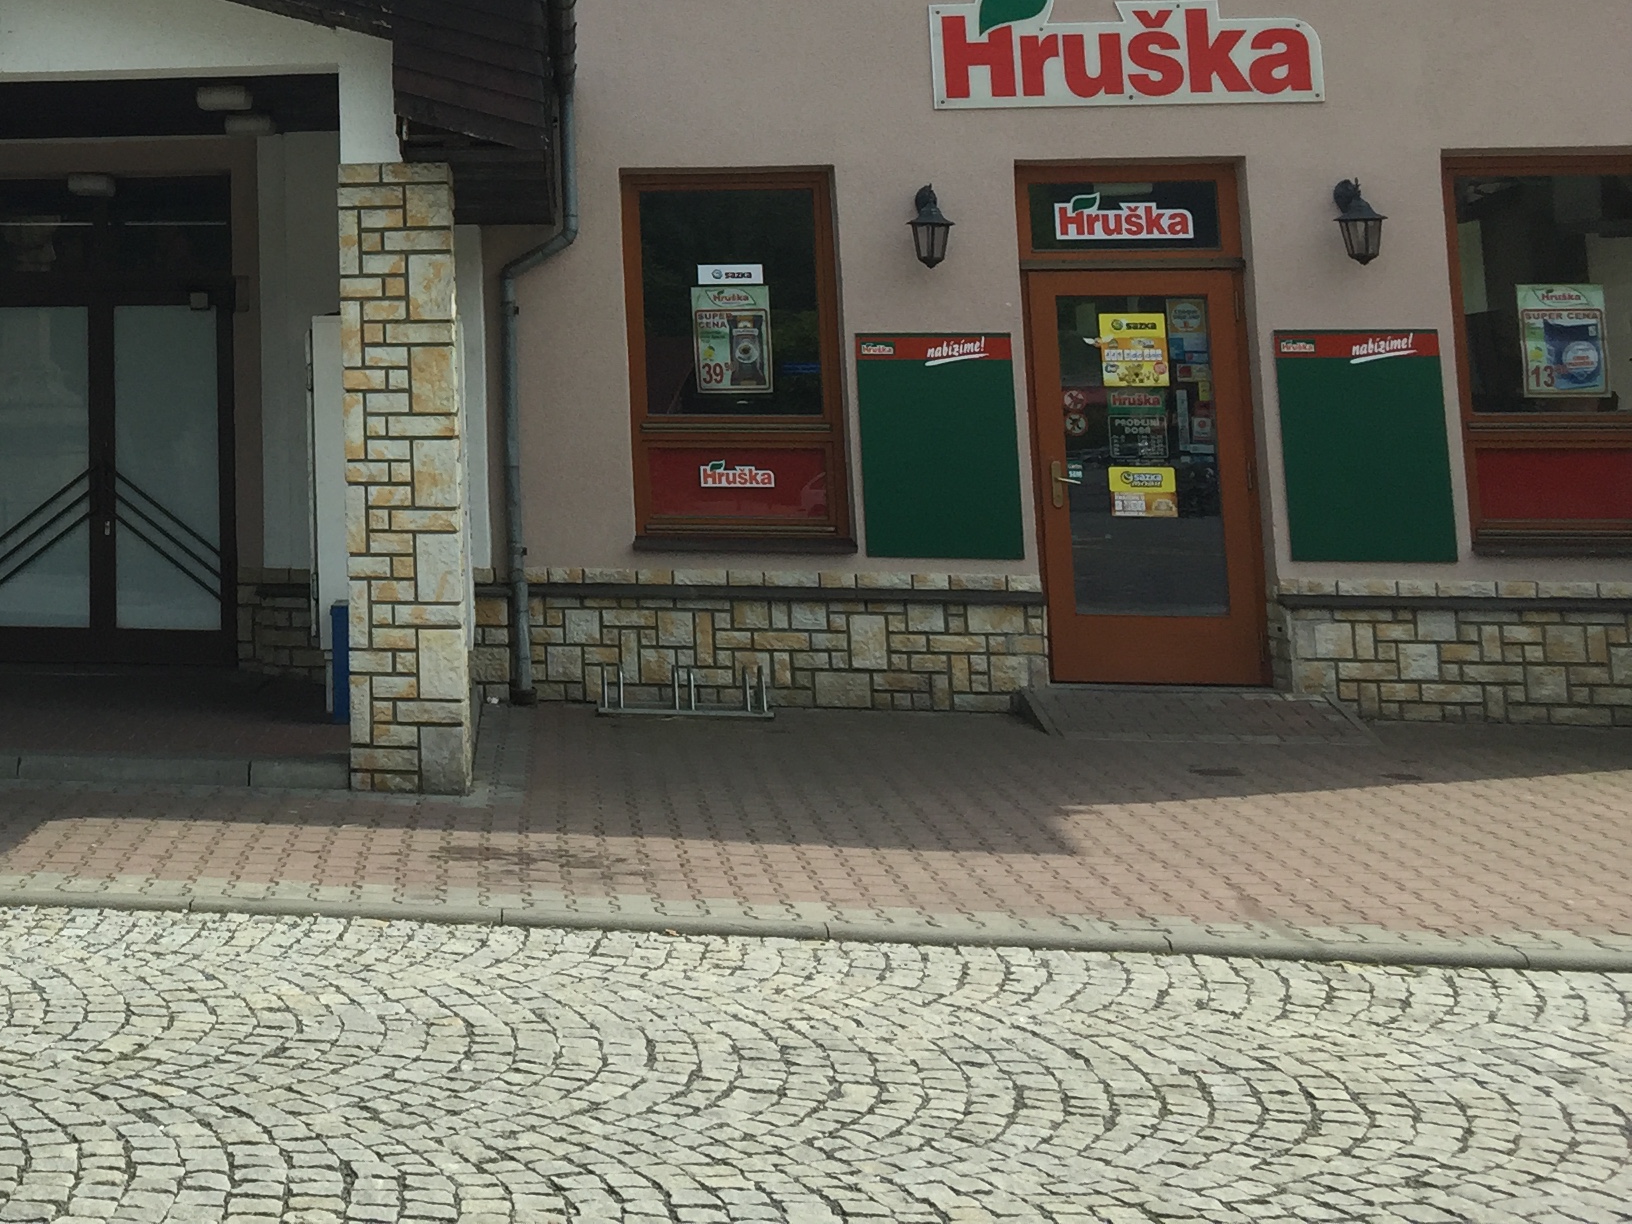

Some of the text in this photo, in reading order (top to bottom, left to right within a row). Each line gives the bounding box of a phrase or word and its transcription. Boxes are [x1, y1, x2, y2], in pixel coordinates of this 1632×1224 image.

[941, 5, 1313, 99] Hruška
[1059, 205, 1190, 236] Hruška
[698, 312, 733, 320] SUPER
[698, 321, 727, 329] CENA
[1525, 312, 1562, 320] SUPER
[927, 336, 986, 358] nabízíme!
[1352, 332, 1414, 356] nabízíme!
[702, 362, 724, 384] 39
[1531, 365, 1555, 387] 13
[703, 468, 772, 485] Hruška
